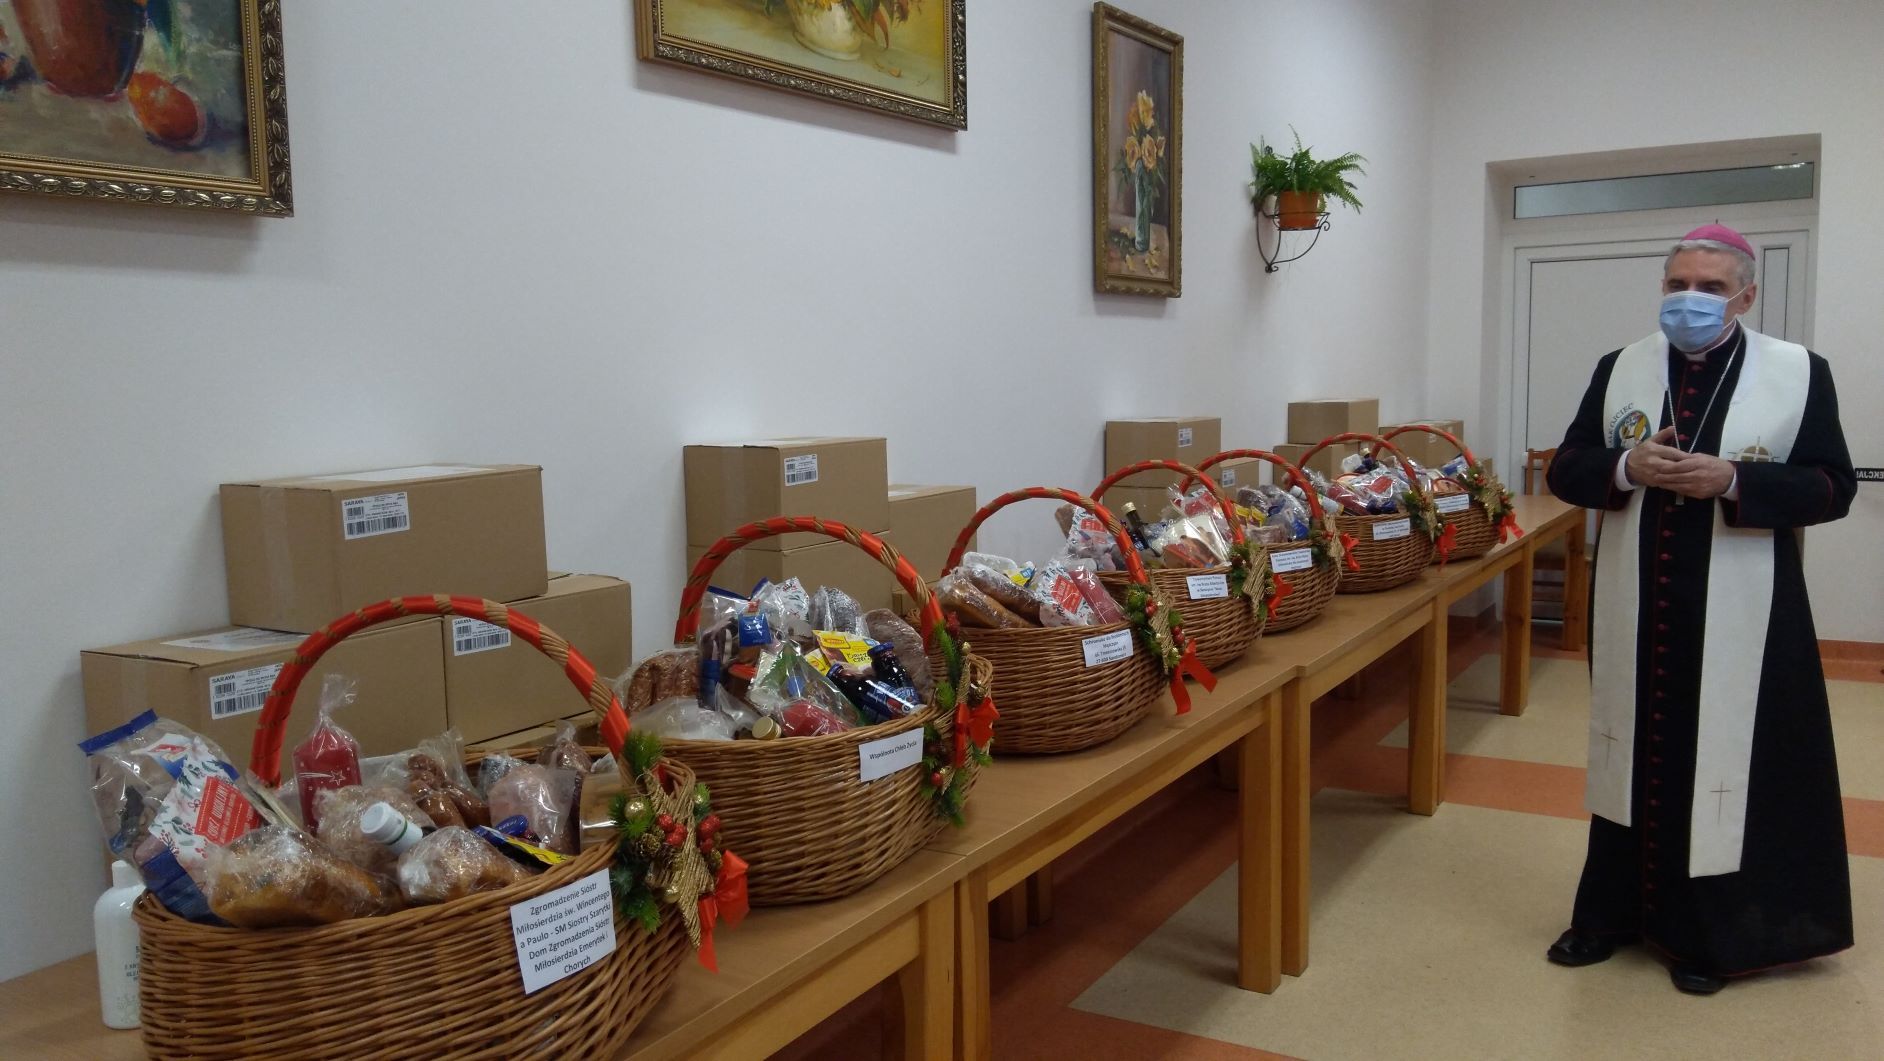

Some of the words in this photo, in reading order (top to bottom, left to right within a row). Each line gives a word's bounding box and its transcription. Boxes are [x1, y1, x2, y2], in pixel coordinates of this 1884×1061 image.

[868, 748, 894, 760] Wspólnota
[894, 744, 907, 753] Chleb
[516, 911, 563, 936] Miłosierdzia
[564, 908, 576, 918] św.
[576, 890, 611, 911] Wincentego
[529, 889, 580, 916] Zgromadzenie
[580, 882, 597, 896] Sióstr
[527, 932, 549, 947] Paulo
[554, 924, 567, 936] SM
[567, 914, 589, 930] Siostry
[589, 902, 611, 919] Szarytki
[528, 947, 548, 960] Dom
[548, 925, 595, 953] Zgromadzenia
[534, 947, 578, 973] Miłosierdzia
[578, 932, 606, 953] Emerytek
[563, 955, 591, 974] Chorych
